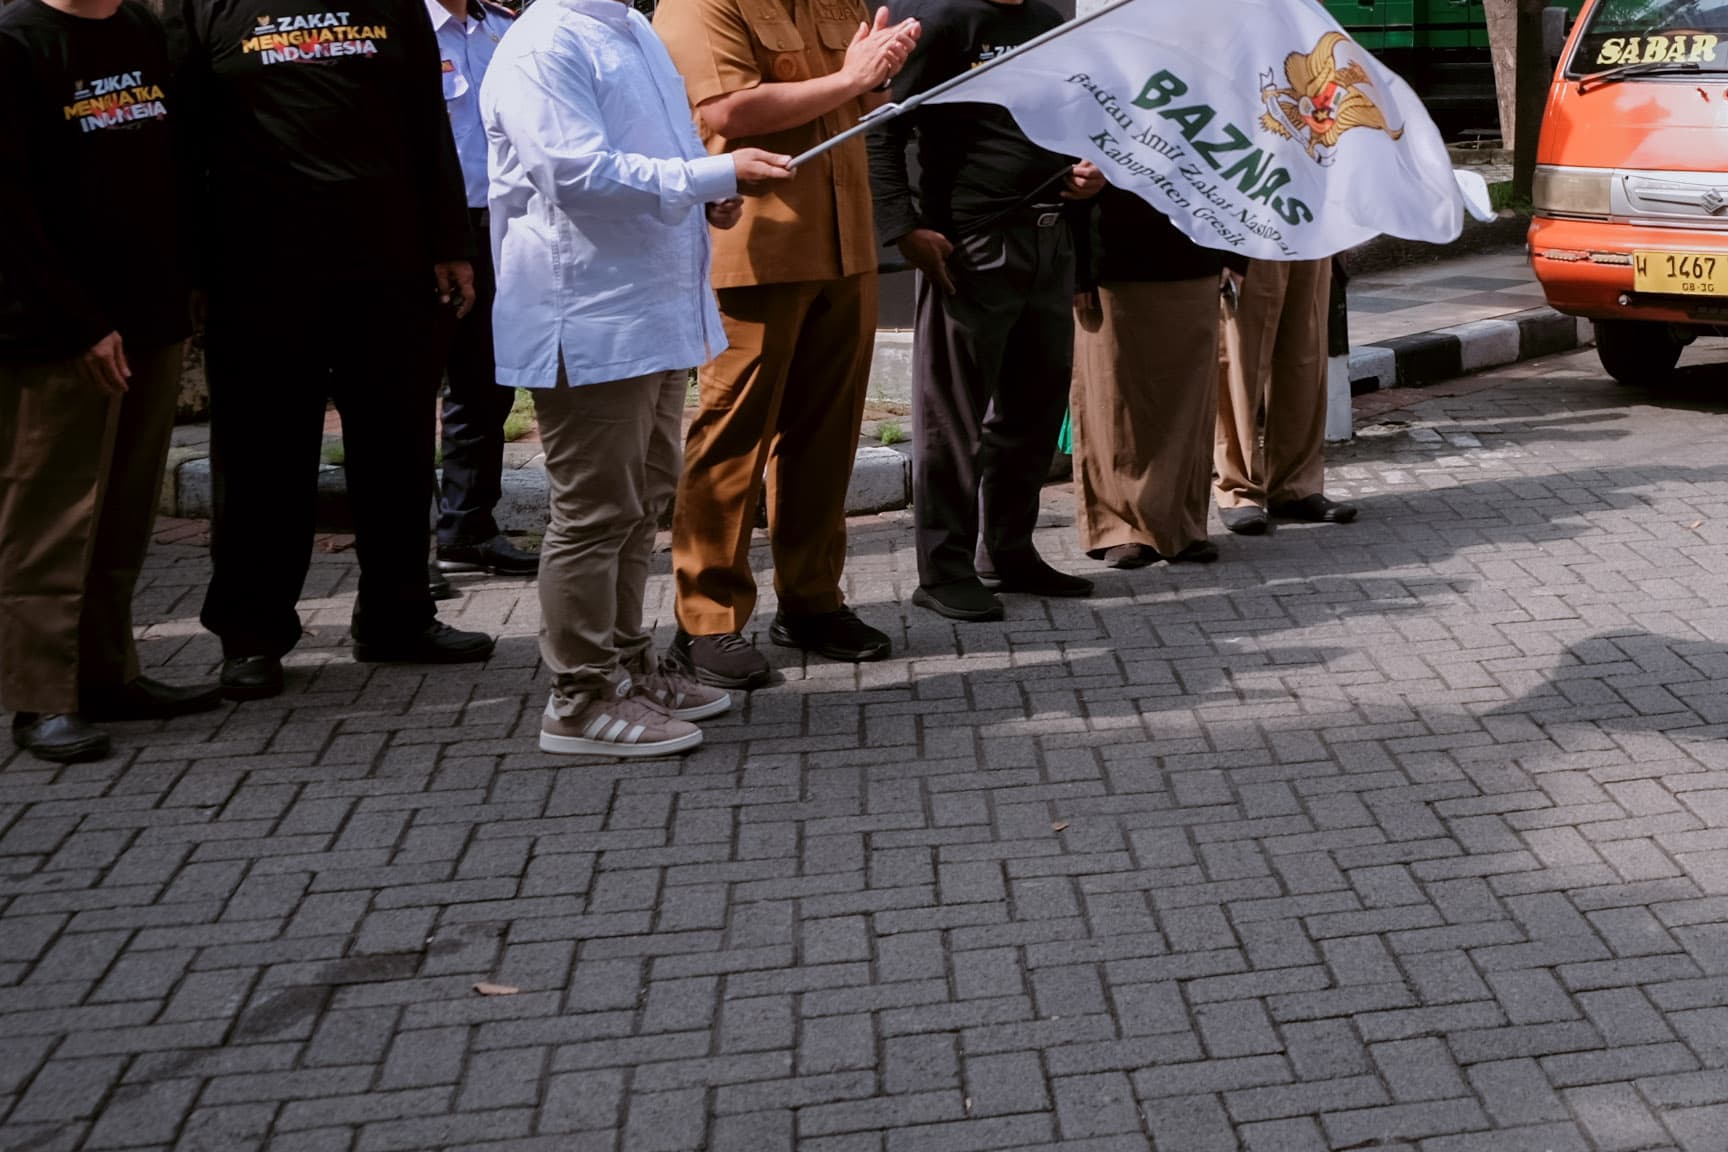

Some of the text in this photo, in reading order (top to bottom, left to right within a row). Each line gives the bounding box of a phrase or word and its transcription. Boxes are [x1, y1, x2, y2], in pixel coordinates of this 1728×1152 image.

[276, 11, 351, 32] ZAKAT
[241, 25, 388, 54] MENGUATKAN
[260, 39, 379, 65] INDONESIA
[1596, 34, 1719, 66] SABAR
[1064, 71, 1135, 132] Badan
[1131, 125, 1185, 164] Amil
[1178, 161, 1234, 211] Zakat
[1130, 69, 1315, 226] BAZNAS
[1088, 128, 1248, 248] Kabupaten Gresik
[1635, 255, 1648, 278] W
[1665, 254, 1717, 280] 1467
